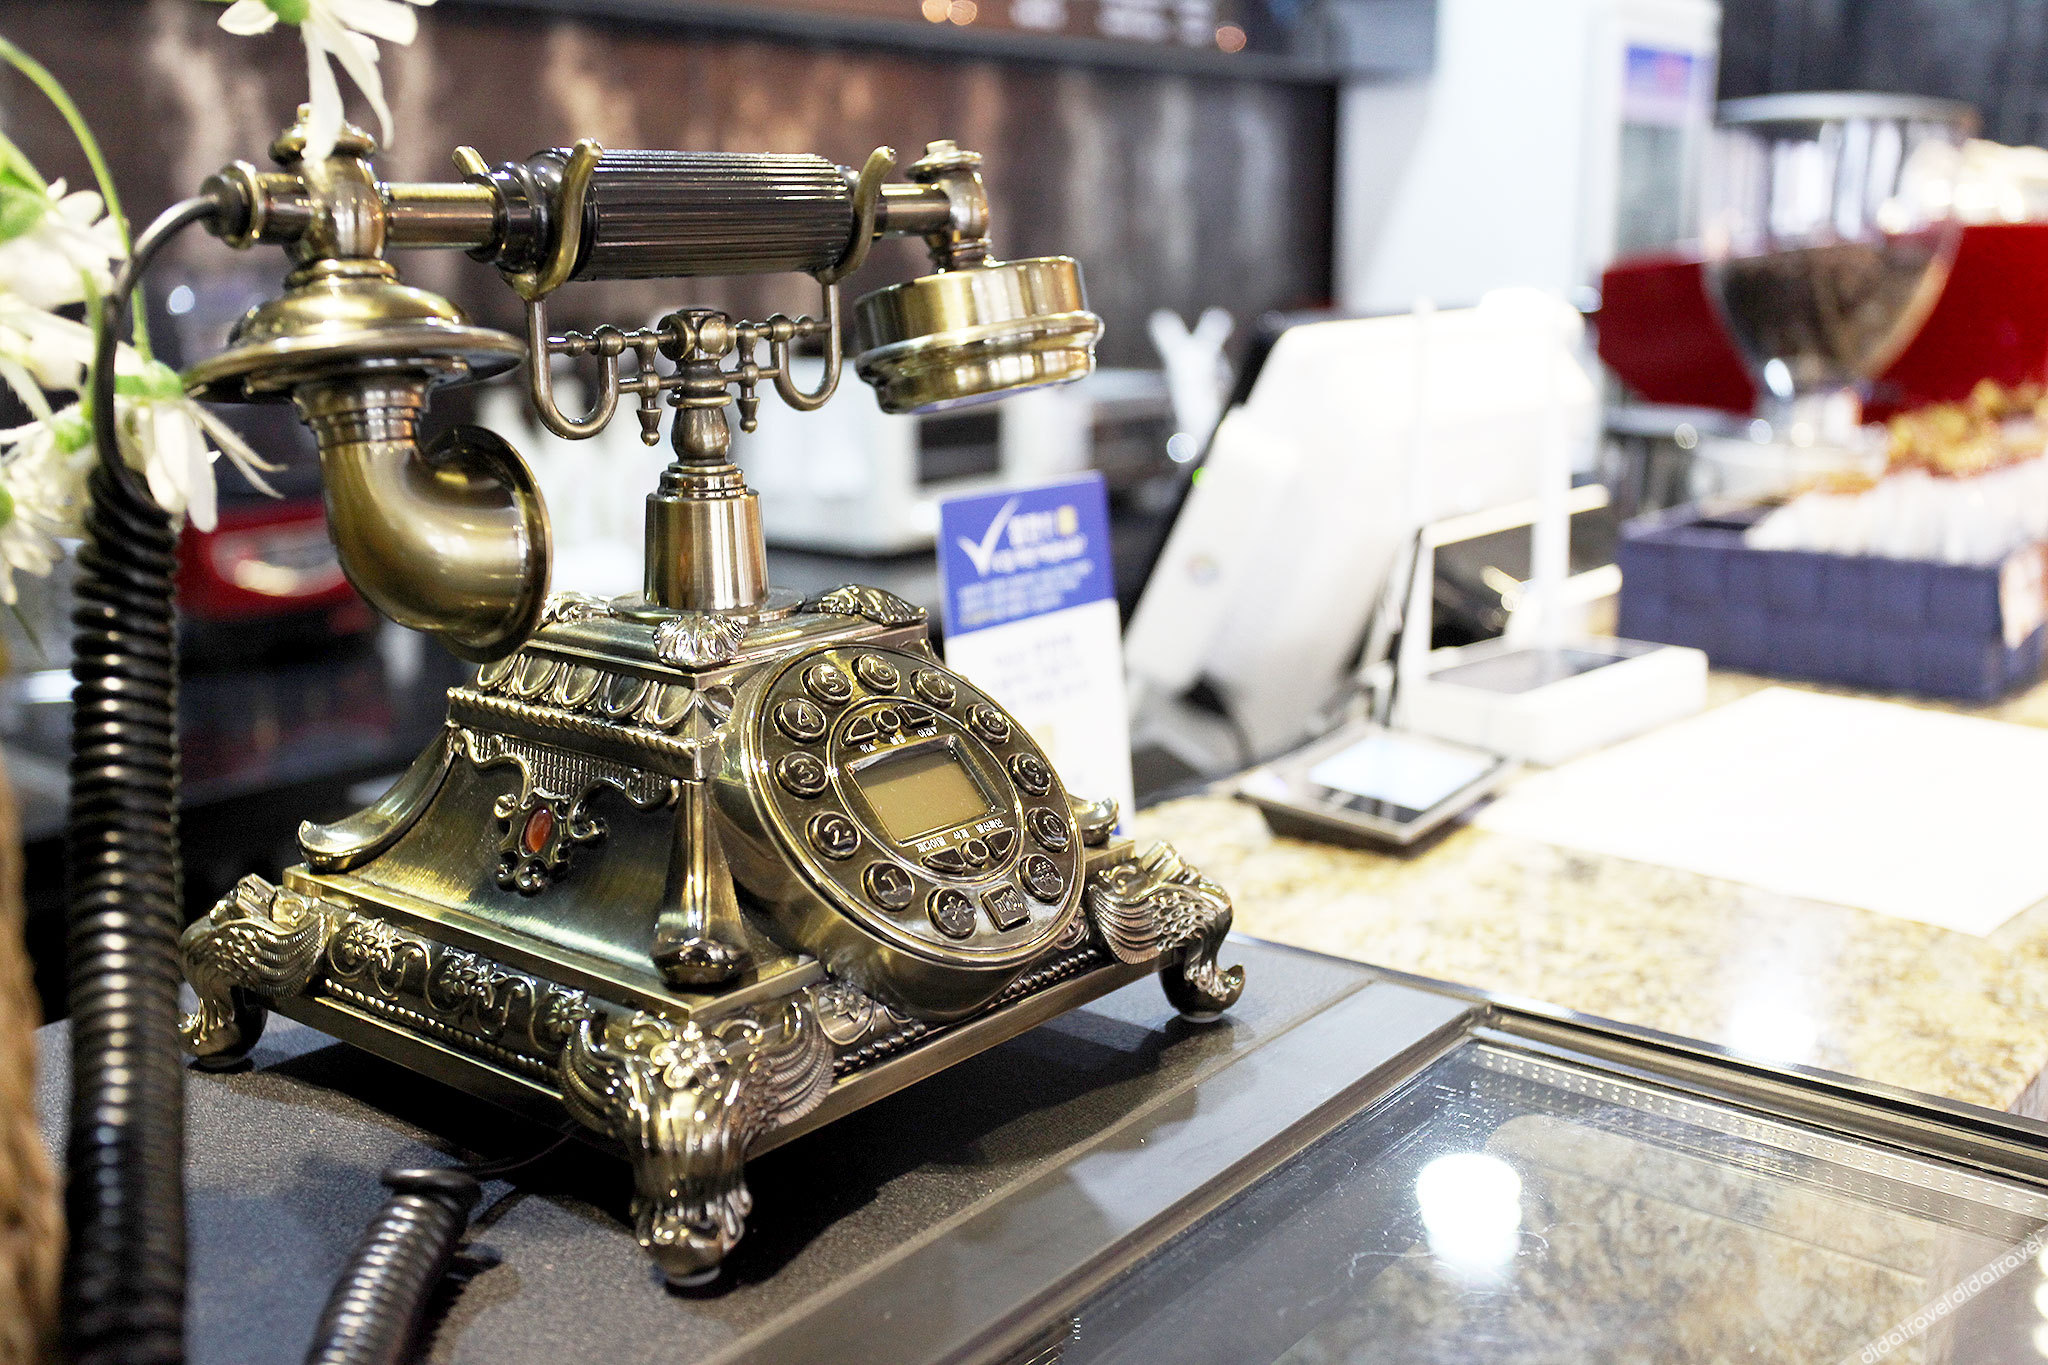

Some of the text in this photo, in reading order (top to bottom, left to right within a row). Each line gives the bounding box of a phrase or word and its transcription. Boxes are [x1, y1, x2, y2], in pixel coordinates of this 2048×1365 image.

[820, 665, 846, 694] 5
[868, 657, 893, 679] 6
[922, 670, 947, 695] 7
[797, 703, 820, 728] 4
[789, 757, 820, 785] 3
[824, 818, 854, 847] 2
